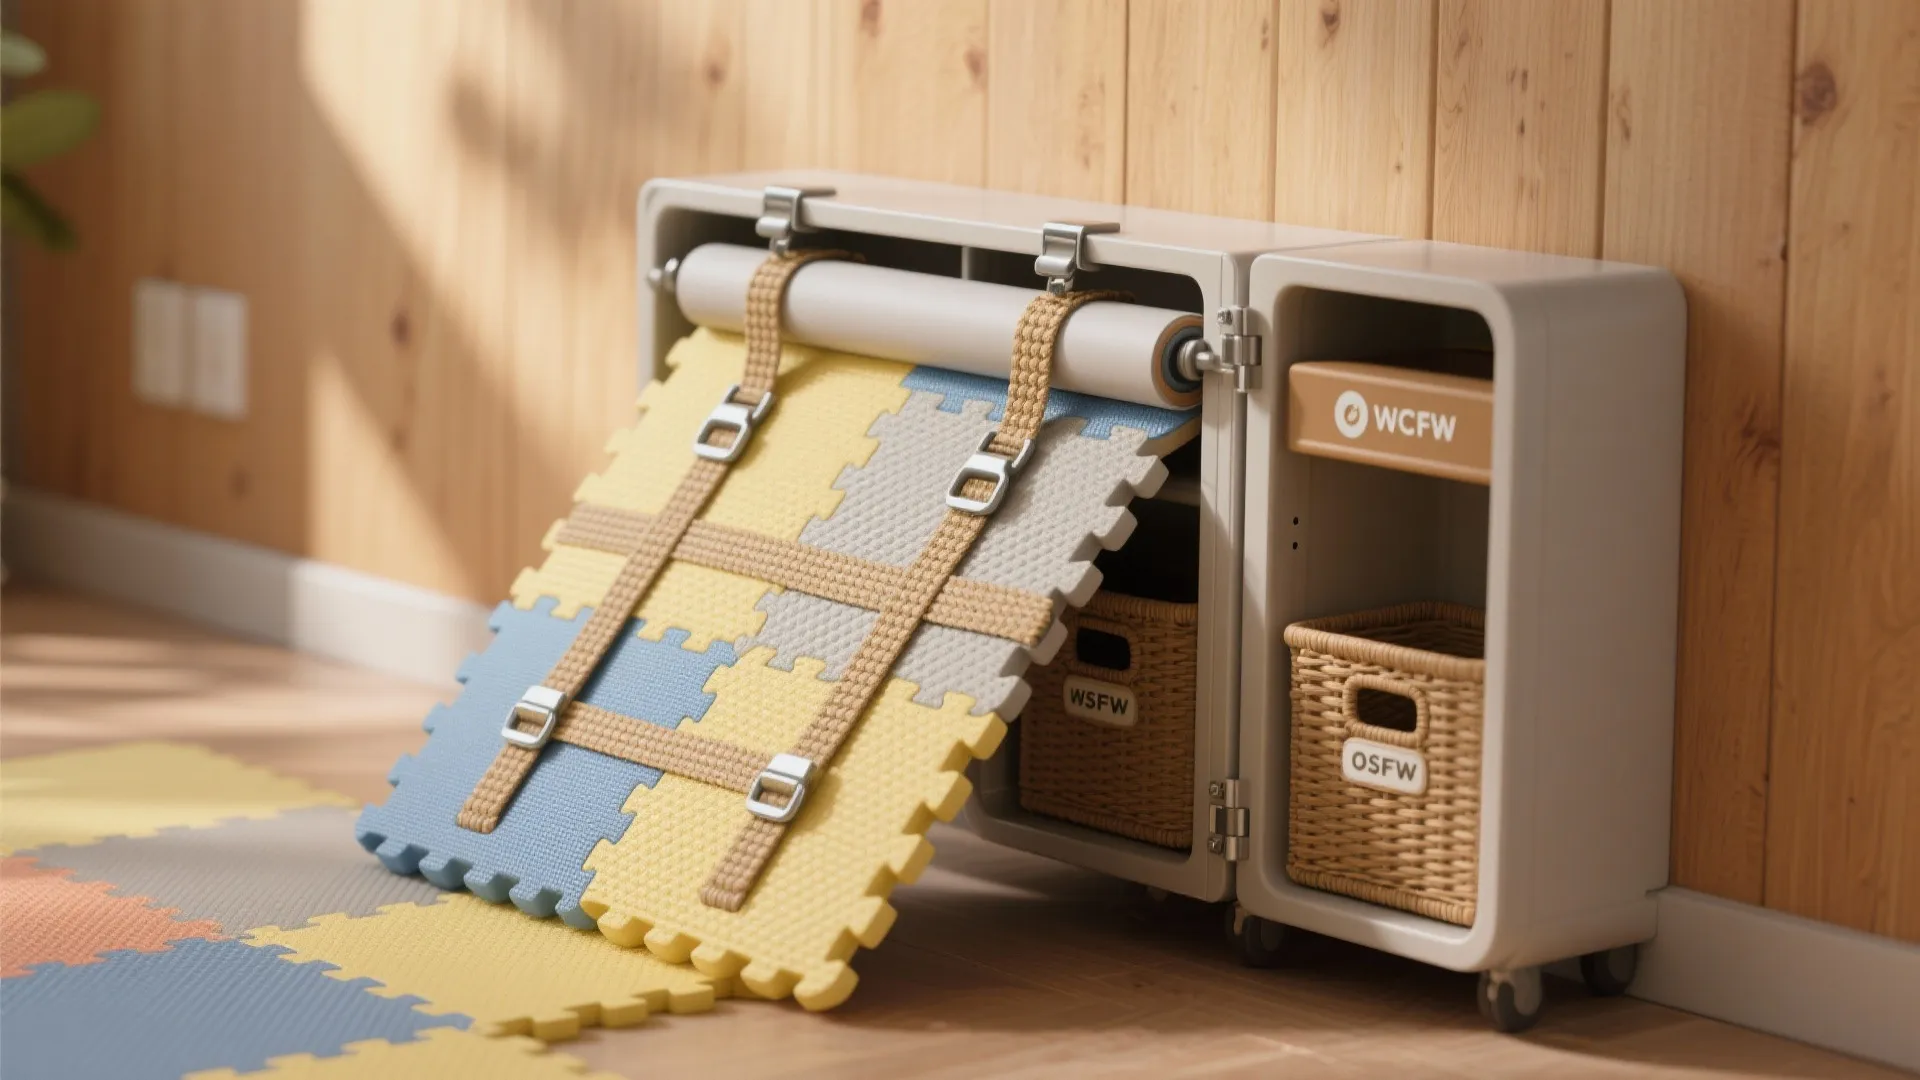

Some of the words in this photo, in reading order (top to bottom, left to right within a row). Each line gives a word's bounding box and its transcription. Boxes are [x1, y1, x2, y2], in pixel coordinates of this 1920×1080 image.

[1373, 404, 1457, 442] WCFW
[1070, 687, 1129, 715] WSFW
[1351, 751, 1417, 781] OSFW
